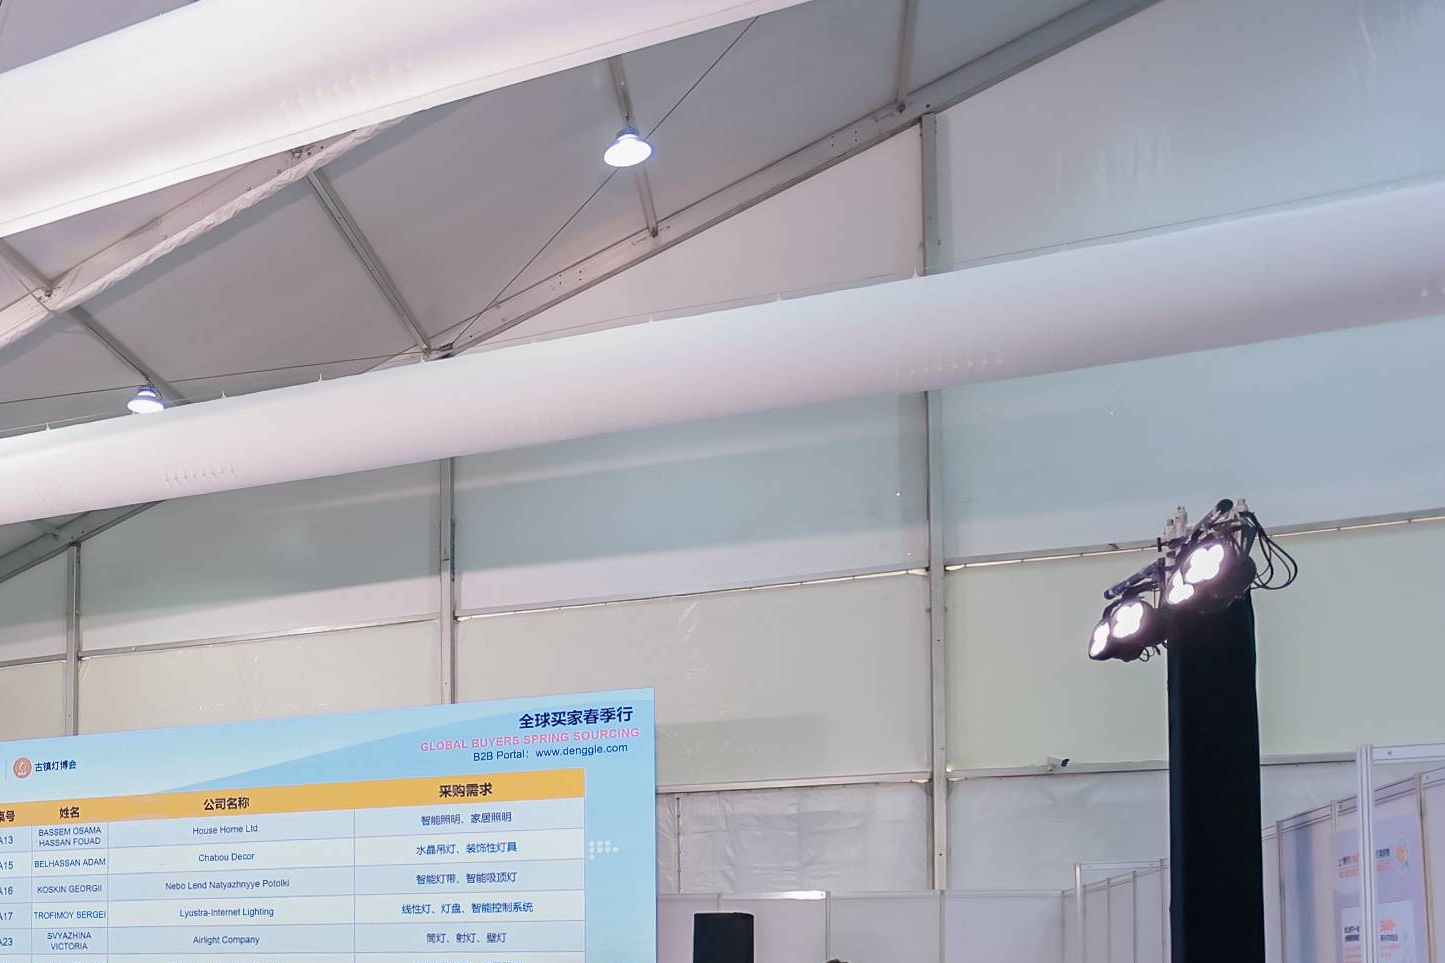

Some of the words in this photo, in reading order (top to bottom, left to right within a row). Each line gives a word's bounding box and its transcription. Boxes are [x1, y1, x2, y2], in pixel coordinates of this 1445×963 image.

[519, 706, 633, 729] 全球买家春季行
[420, 738, 468, 752] GLOBAL
[472, 735, 520, 748] BUYERS
[524, 732, 569, 745] SPRING
[573, 727, 640, 742] SOURCING
[473, 752, 494, 762] B2B
[535, 743, 628, 757] www.denggle.com
[35, 760, 77, 772] 古镇灯博会
[438, 783, 493, 799] 采购需求
[203, 797, 250, 811] 公司名称
[59, 807, 80, 819] 姓名
[420, 811, 512, 826] 智能照明、家居照明
[38, 828, 70, 837] BASSEM
[72, 826, 101, 835] OSAMA
[192, 826, 217, 836] House
[219, 825, 242, 834] Home
[245, 824, 258, 833] Ltd
[39, 838, 70, 847] HASSAN
[72, 837, 101, 846] FOUAD
[198, 853, 228, 862] Chabou
[231, 852, 255, 861] Decor
[34, 858, 80, 868] BELHASSAN
[82, 858, 106, 867] ADAM
[37, 885, 67, 894] KOSKIN
[68, 884, 102, 893] GEORGII
[165, 882, 185, 891] Nebo
[188, 881, 207, 890] Lend
[76, 911, 106, 919] SERGEI
[179, 908, 241, 918] Lyustra-Internet
[242, 907, 274, 918] Lighting
[47, 932, 92, 940] SVYAZHINA
[193, 935, 220, 946] Airlight
[222, 935, 260, 947] Company
[51, 943, 88, 951] VICTORIA
